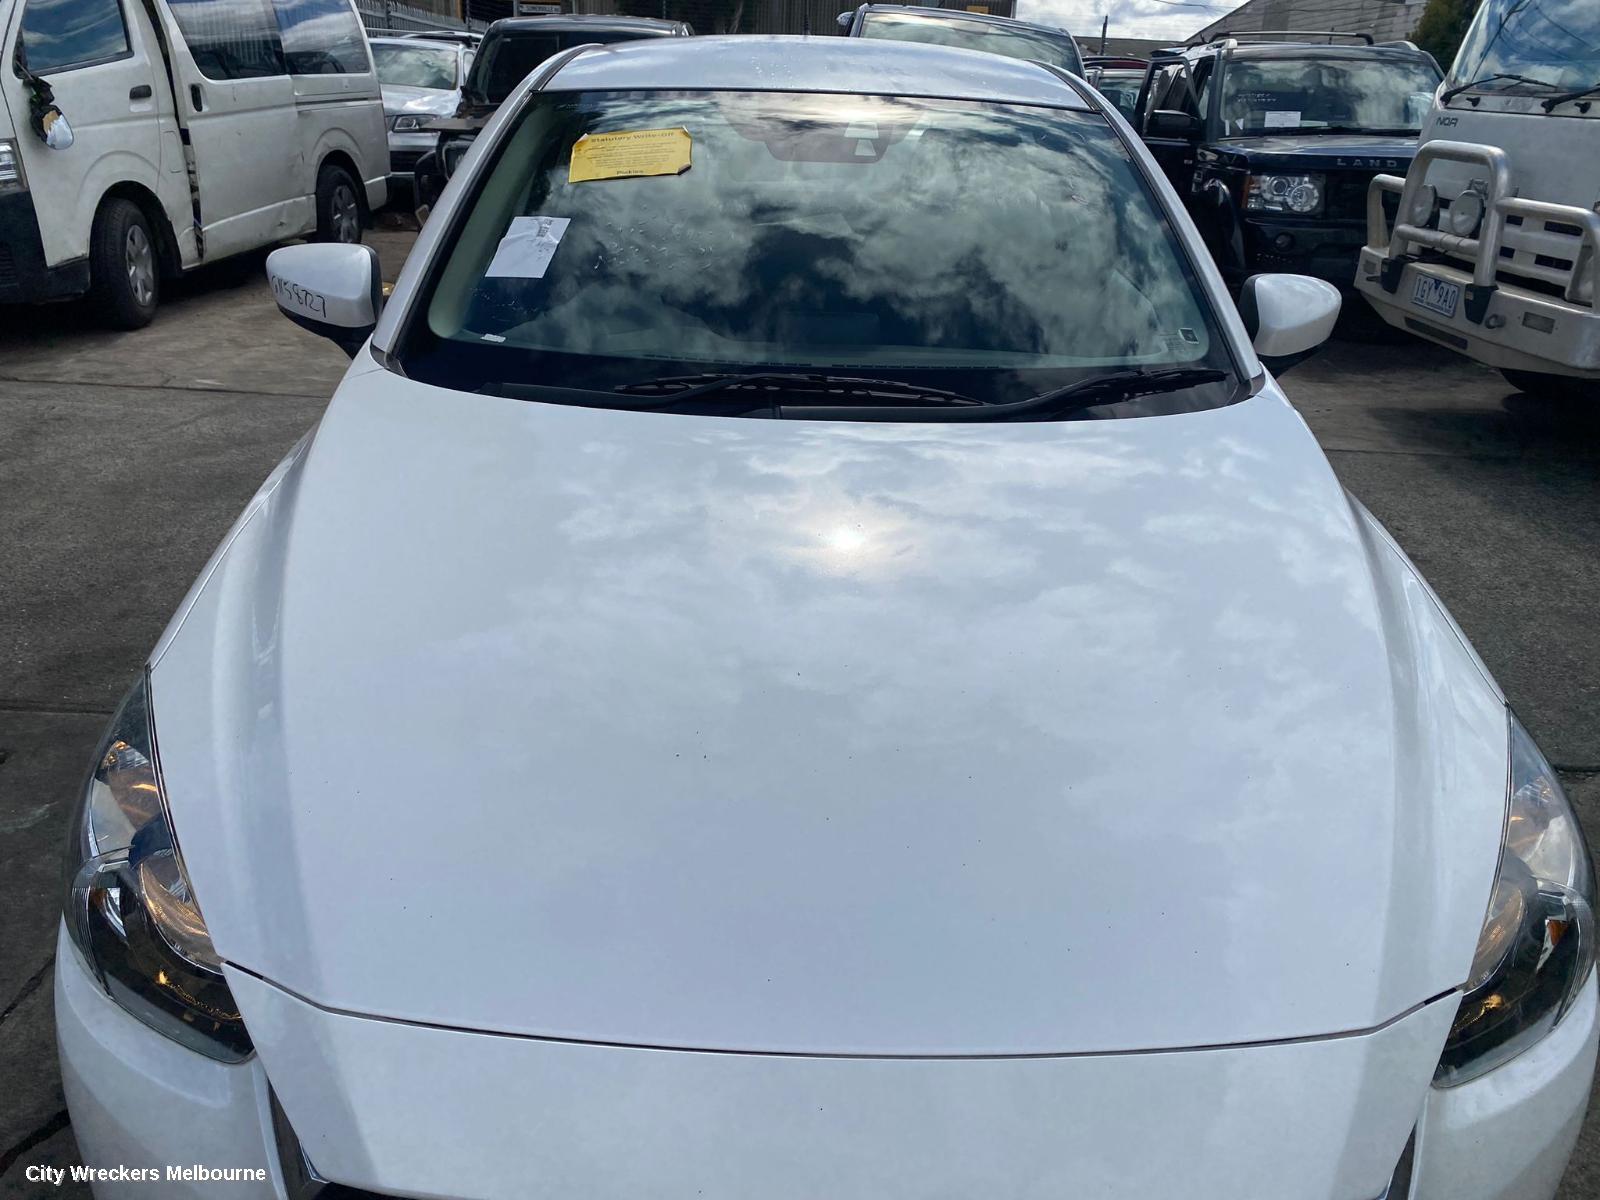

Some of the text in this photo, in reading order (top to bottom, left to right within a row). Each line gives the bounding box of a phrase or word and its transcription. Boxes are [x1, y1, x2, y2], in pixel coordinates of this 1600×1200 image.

[591, 135, 631, 143] Statutory
[1336, 158, 1398, 168] LAND
[1415, 278, 1434, 300] 1GY
